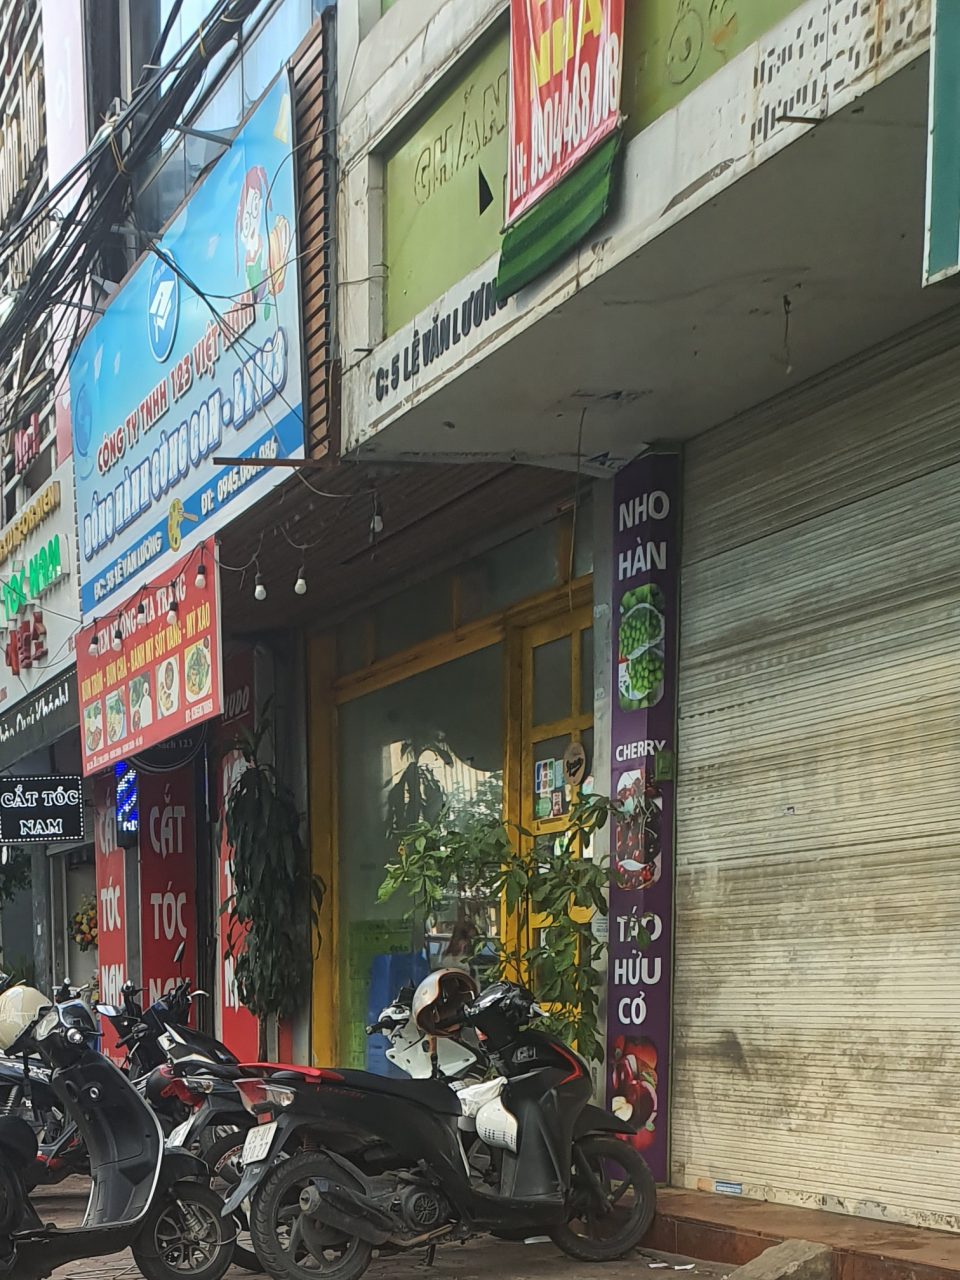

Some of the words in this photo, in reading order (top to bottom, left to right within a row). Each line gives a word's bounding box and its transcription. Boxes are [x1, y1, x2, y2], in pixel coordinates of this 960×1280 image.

[403, 329, 421, 382] LÊ
[422, 314, 451, 368] VĂN
[452, 276, 509, 346] LƯƠN
[97, 426, 126, 477] CÔNG
[125, 414, 140, 451] TY
[140, 379, 170, 435] TNHH
[170, 352, 193, 403] 123
[193, 319, 222, 380] VIỆT
[115, 466, 152, 535] HÀNH
[151, 429, 190, 502] CÙNG
[189, 387, 224, 469] CON
[618, 489, 671, 533] NHO
[618, 537, 668, 581] HÀN
[615, 738, 668, 762] CHERRY
[1, 784, 38, 808] CẮT
[42, 785, 80, 807] TÓC
[149, 783, 187, 860] CẮT
[19, 818, 63, 837] NAM
[100, 876, 122, 934] TÓC
[150, 880, 188, 941] TÓC
